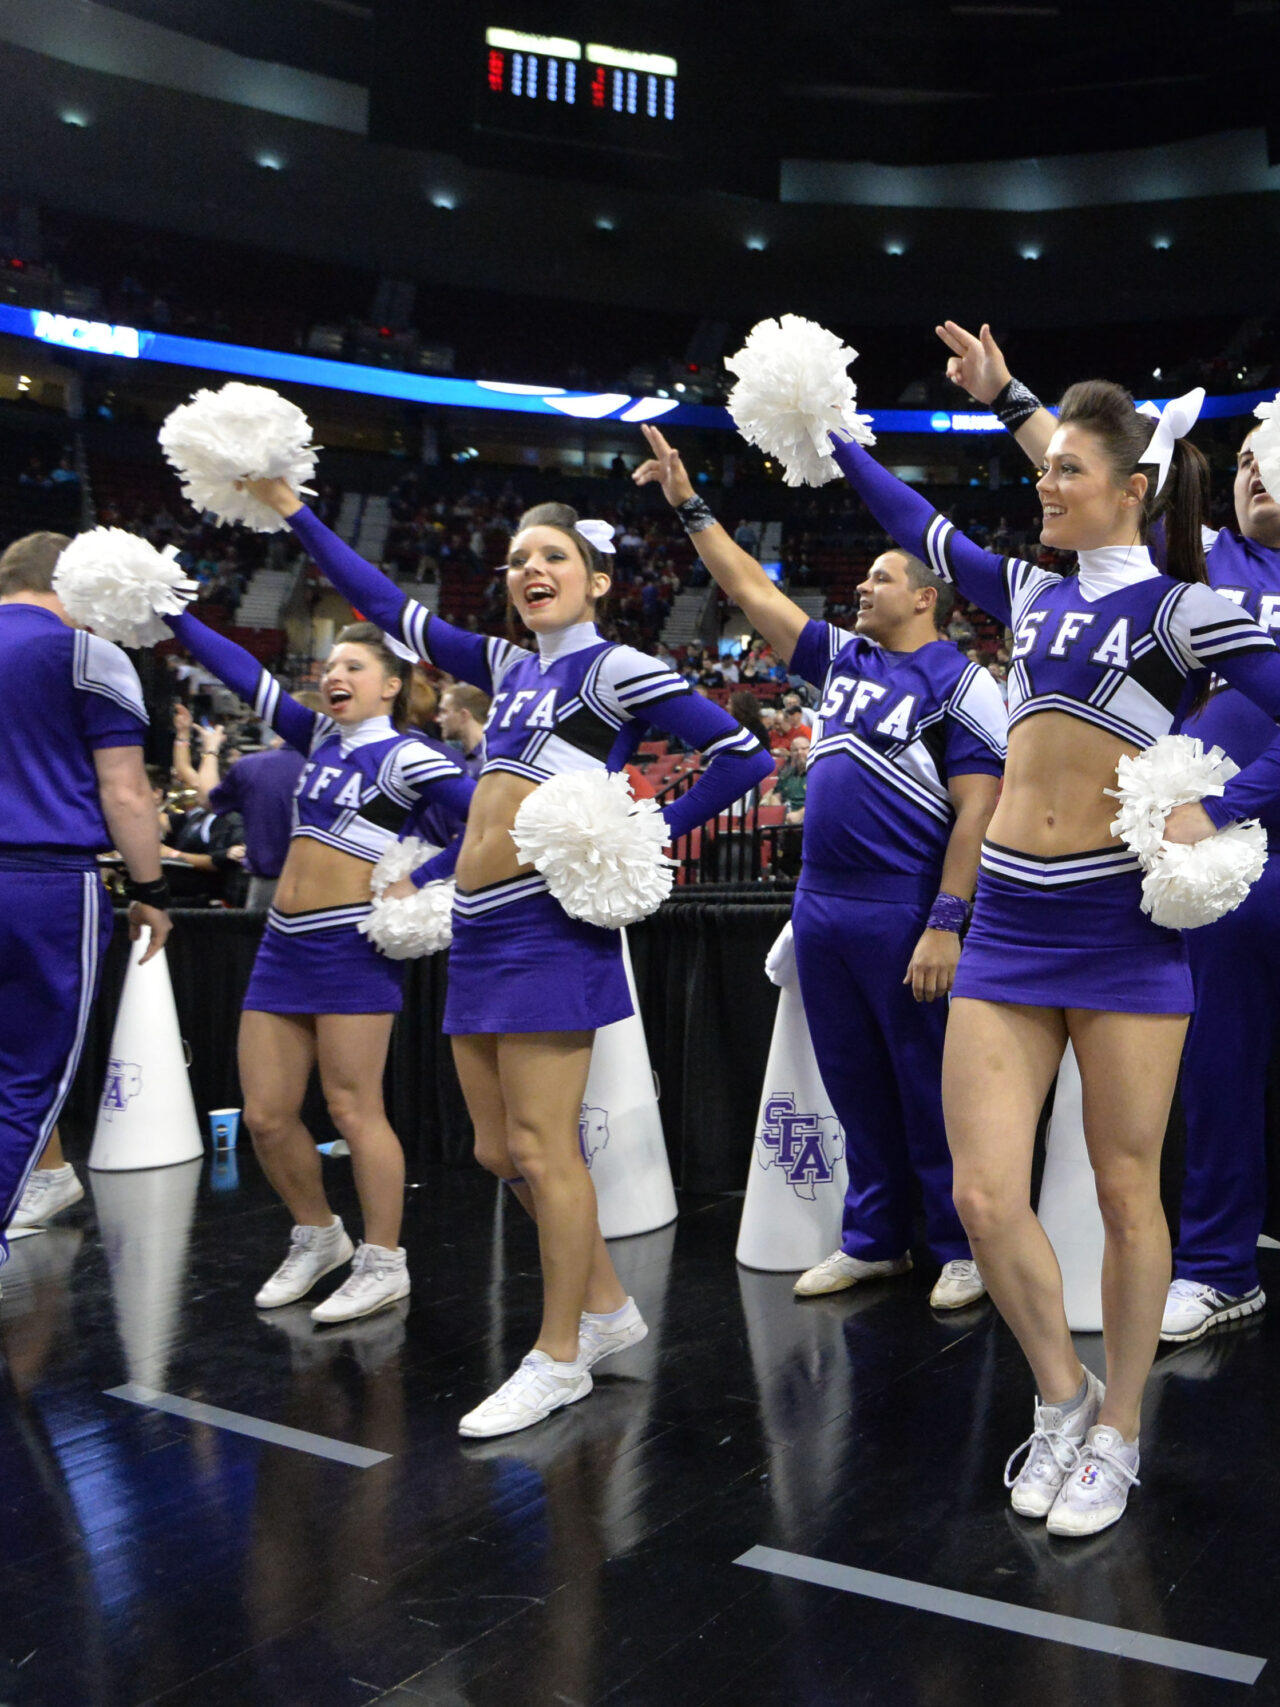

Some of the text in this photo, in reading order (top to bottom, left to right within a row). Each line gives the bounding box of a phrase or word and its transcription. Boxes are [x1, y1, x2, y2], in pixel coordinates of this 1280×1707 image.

[1010, 610, 1130, 669] SFA
[819, 675, 916, 741] SFA
[762, 1097, 834, 1184] SFA
